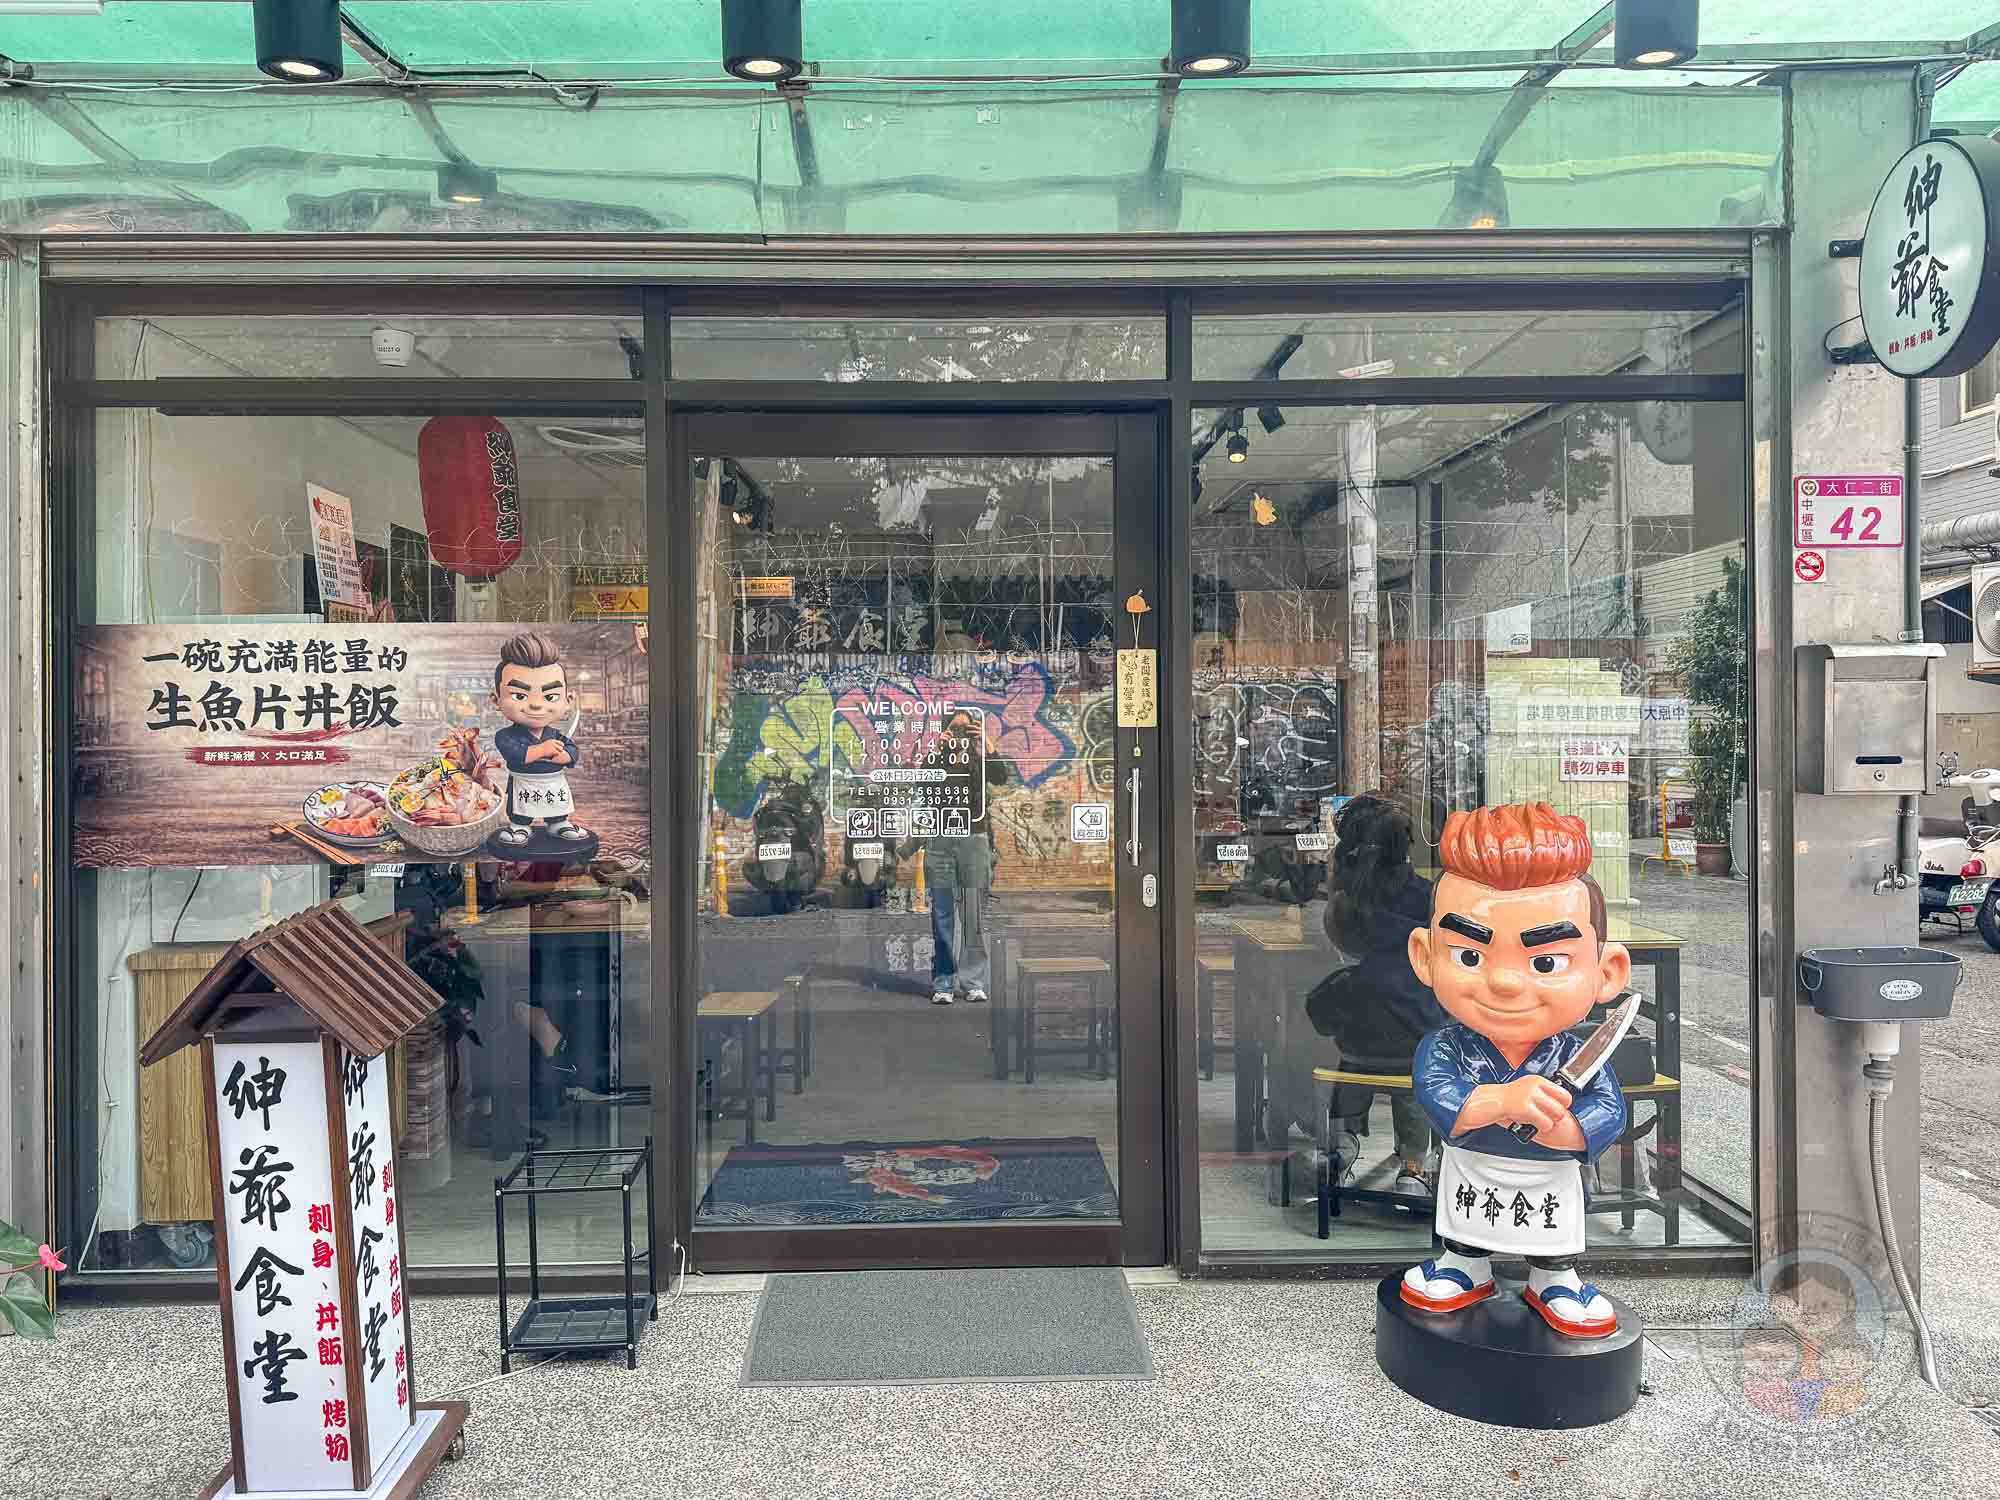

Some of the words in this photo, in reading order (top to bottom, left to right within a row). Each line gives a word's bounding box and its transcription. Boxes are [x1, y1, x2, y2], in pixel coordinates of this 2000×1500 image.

[1826, 481, 1893, 494] 大仁二街
[1801, 498, 1814, 541] 中壢區
[1830, 506, 1882, 541] 42
[147, 680, 403, 732] 生魚片丼飯
[862, 701, 955, 715] WELCOME
[874, 720, 942, 734] 營業時間
[848, 738, 970, 750] 11:00-14:00
[848, 753, 970, 765] 17:00-20:00
[873, 770, 945, 782] 公休日另行公告
[1564, 760, 1626, 776] 請勿停車
[884, 796, 969, 805] 0931-230-714
[1455, 1183, 1560, 1229] 紳爺食堂
[342, 1047, 389, 1384] 紳爺食堂
[222, 1056, 308, 1404] 紳爺食堂
[308, 1203, 350, 1463] 刺身、丼飯、烤物
